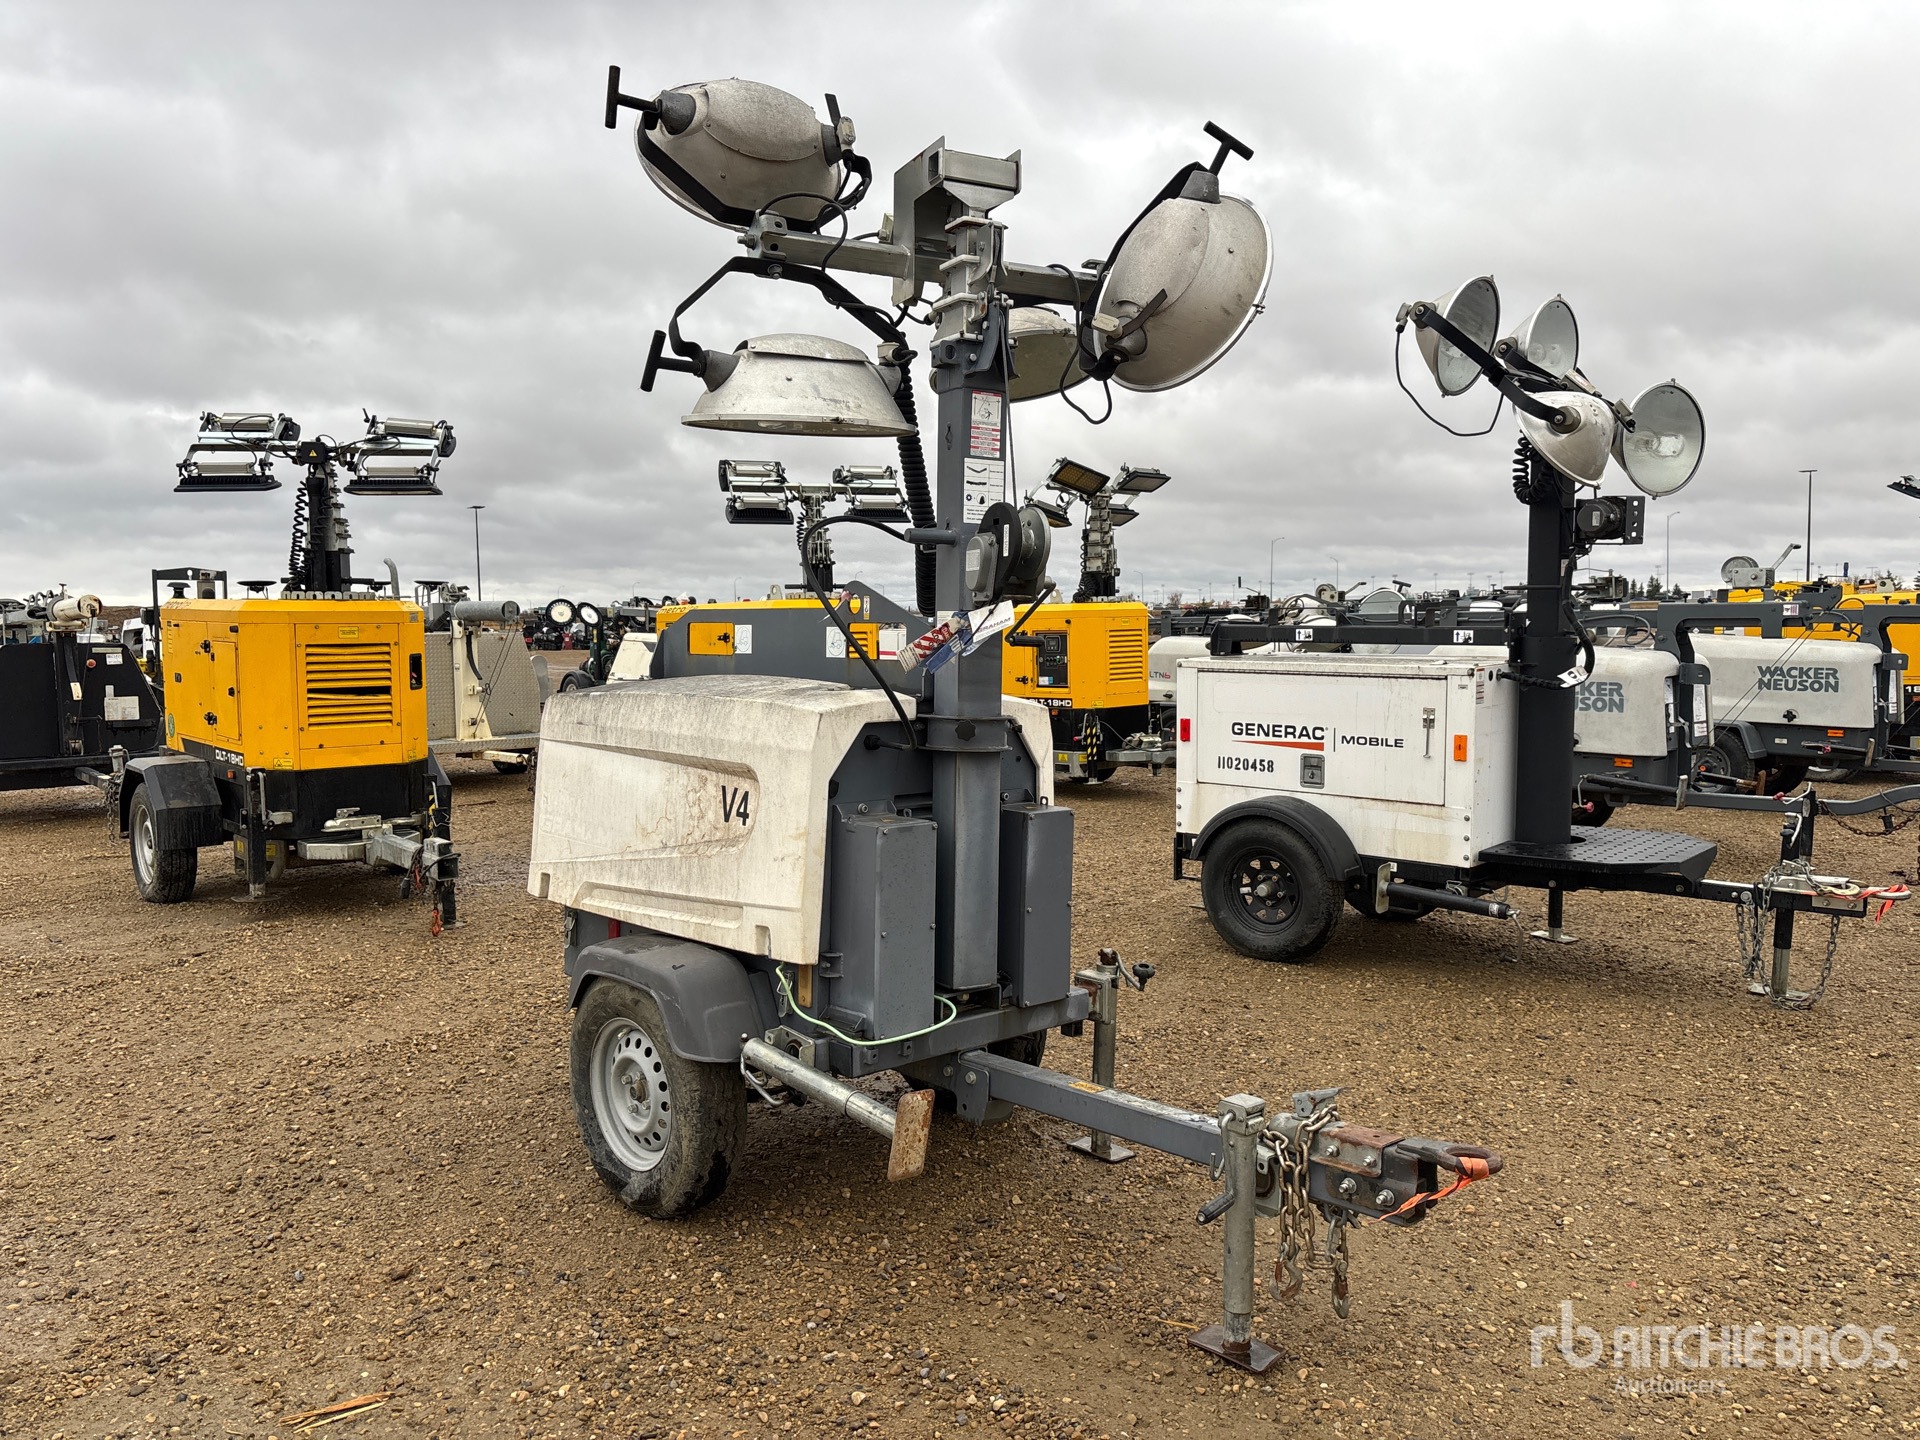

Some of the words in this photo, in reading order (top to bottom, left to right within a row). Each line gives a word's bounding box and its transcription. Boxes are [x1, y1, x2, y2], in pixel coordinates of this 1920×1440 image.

[1149, 671, 1171, 679] LTN6
[1757, 665, 1839, 680] WACKER
[1575, 681, 1625, 697] KER
[1757, 678, 1839, 693] NEUSON
[1231, 721, 1325, 740] GENERAC
[1341, 735, 1404, 748] MOBILE
[1217, 755, 1274, 772] 11020458
[721, 785, 750, 826] V4
